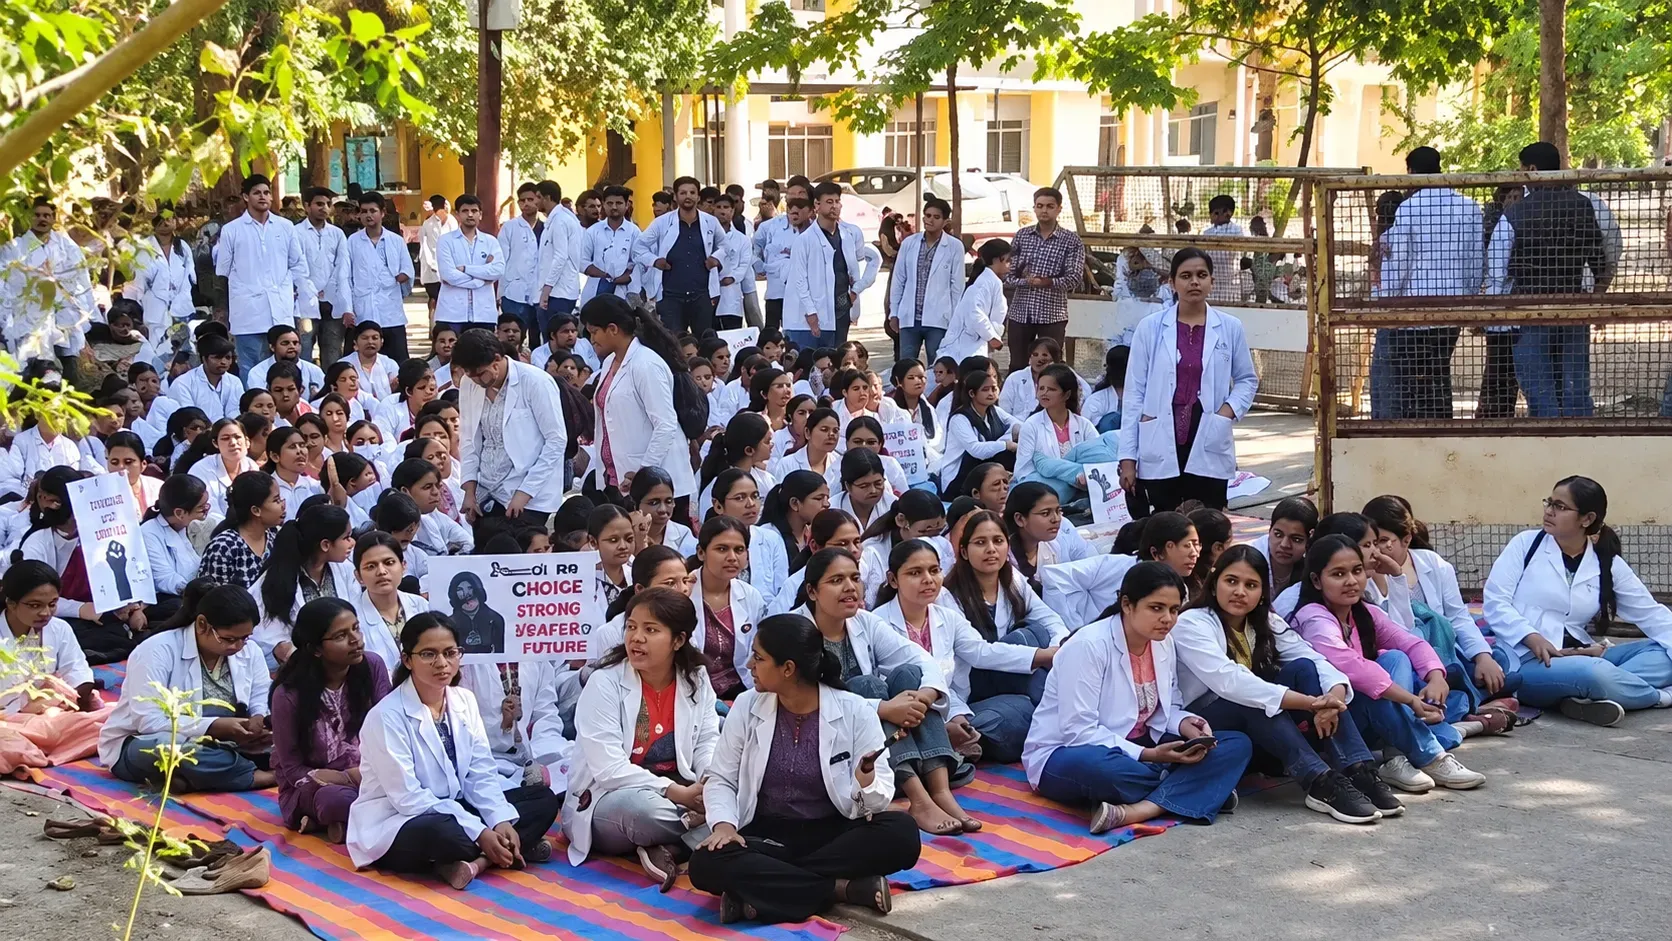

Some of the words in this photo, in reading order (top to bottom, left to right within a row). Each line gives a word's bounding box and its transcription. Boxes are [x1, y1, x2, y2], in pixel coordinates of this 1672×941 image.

[512, 579, 583, 597] CHOICE
[517, 601, 581, 618] STRONG
[523, 640, 588, 655] FUTURE
